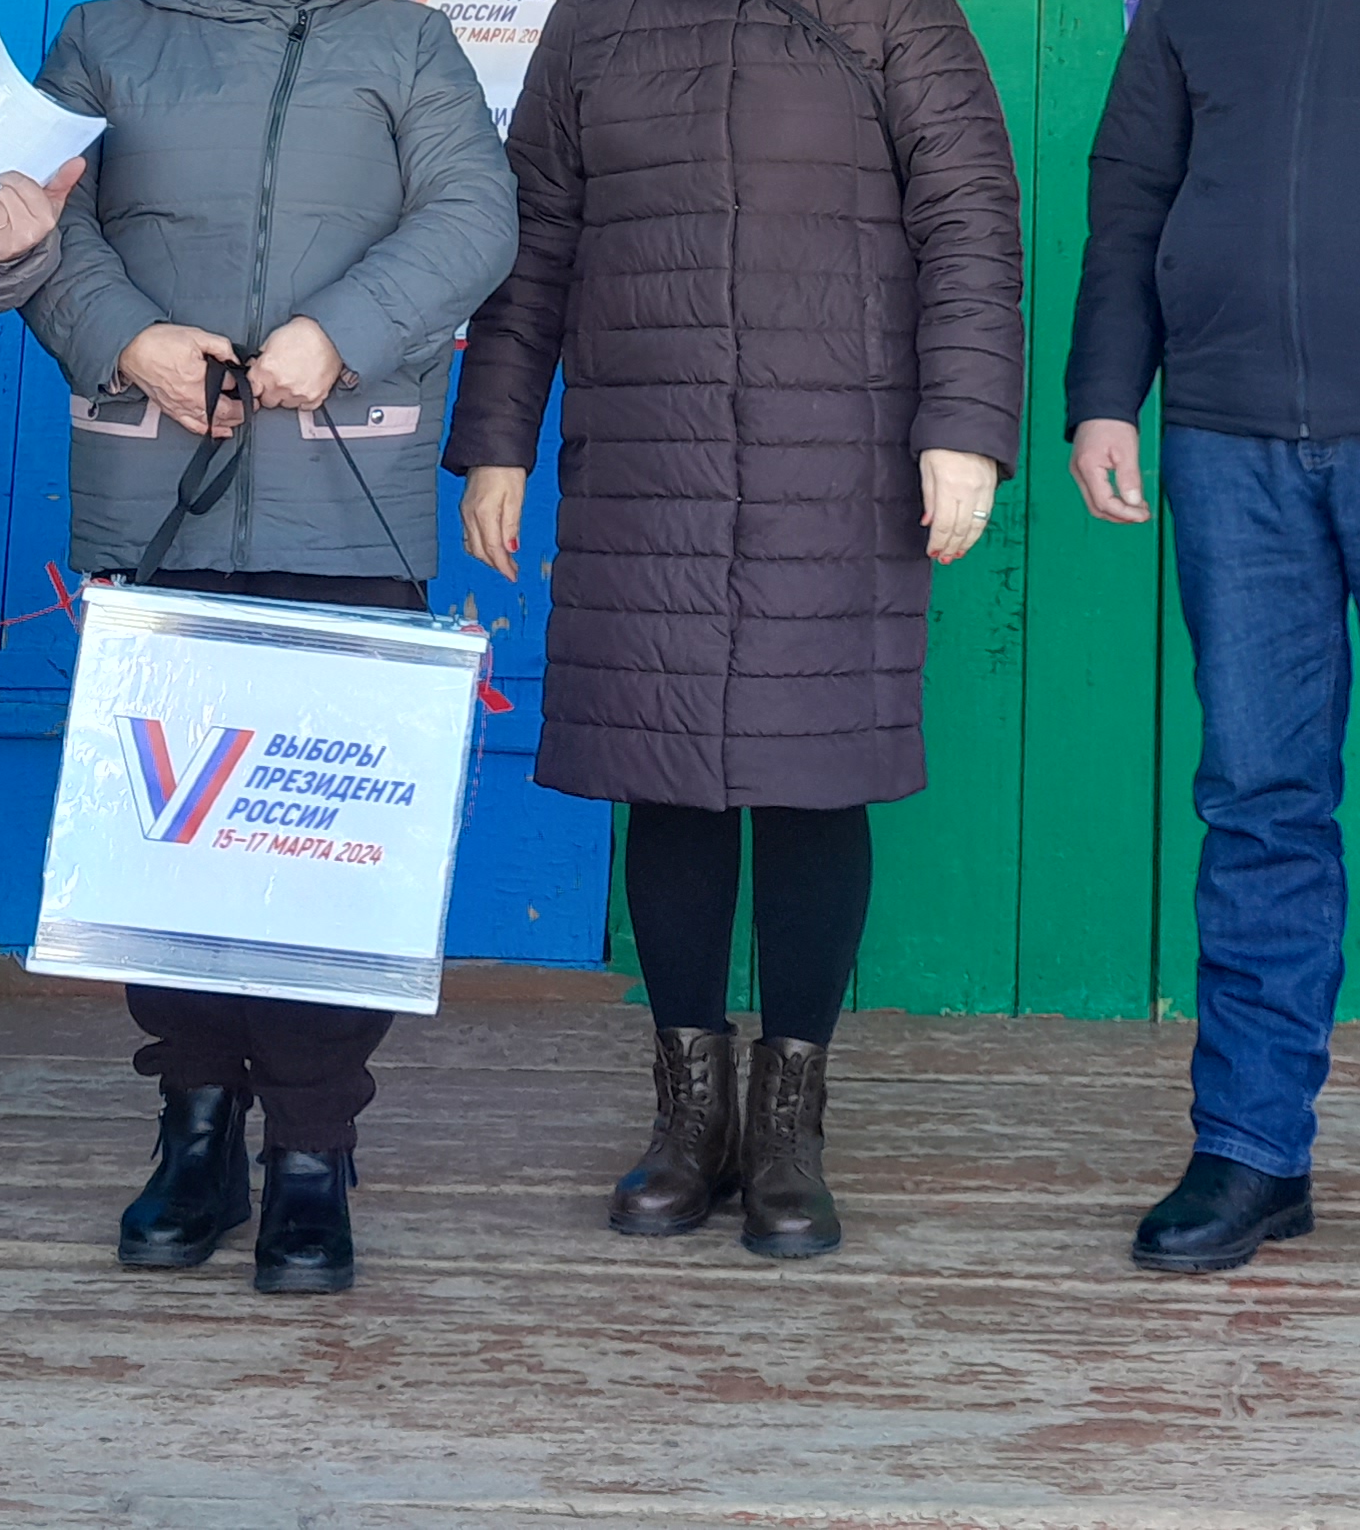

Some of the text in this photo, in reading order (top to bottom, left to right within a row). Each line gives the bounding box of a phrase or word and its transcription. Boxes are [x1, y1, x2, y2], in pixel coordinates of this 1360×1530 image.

[467, 27, 516, 43] МАРТА
[263, 733, 387, 769] ВЫБОРЫ
[244, 765, 417, 807] ПРЕЗИДЕНТА
[227, 797, 340, 831] РОССИИ
[267, 834, 334, 861] МАРТА
[335, 840, 384, 866] 2024
